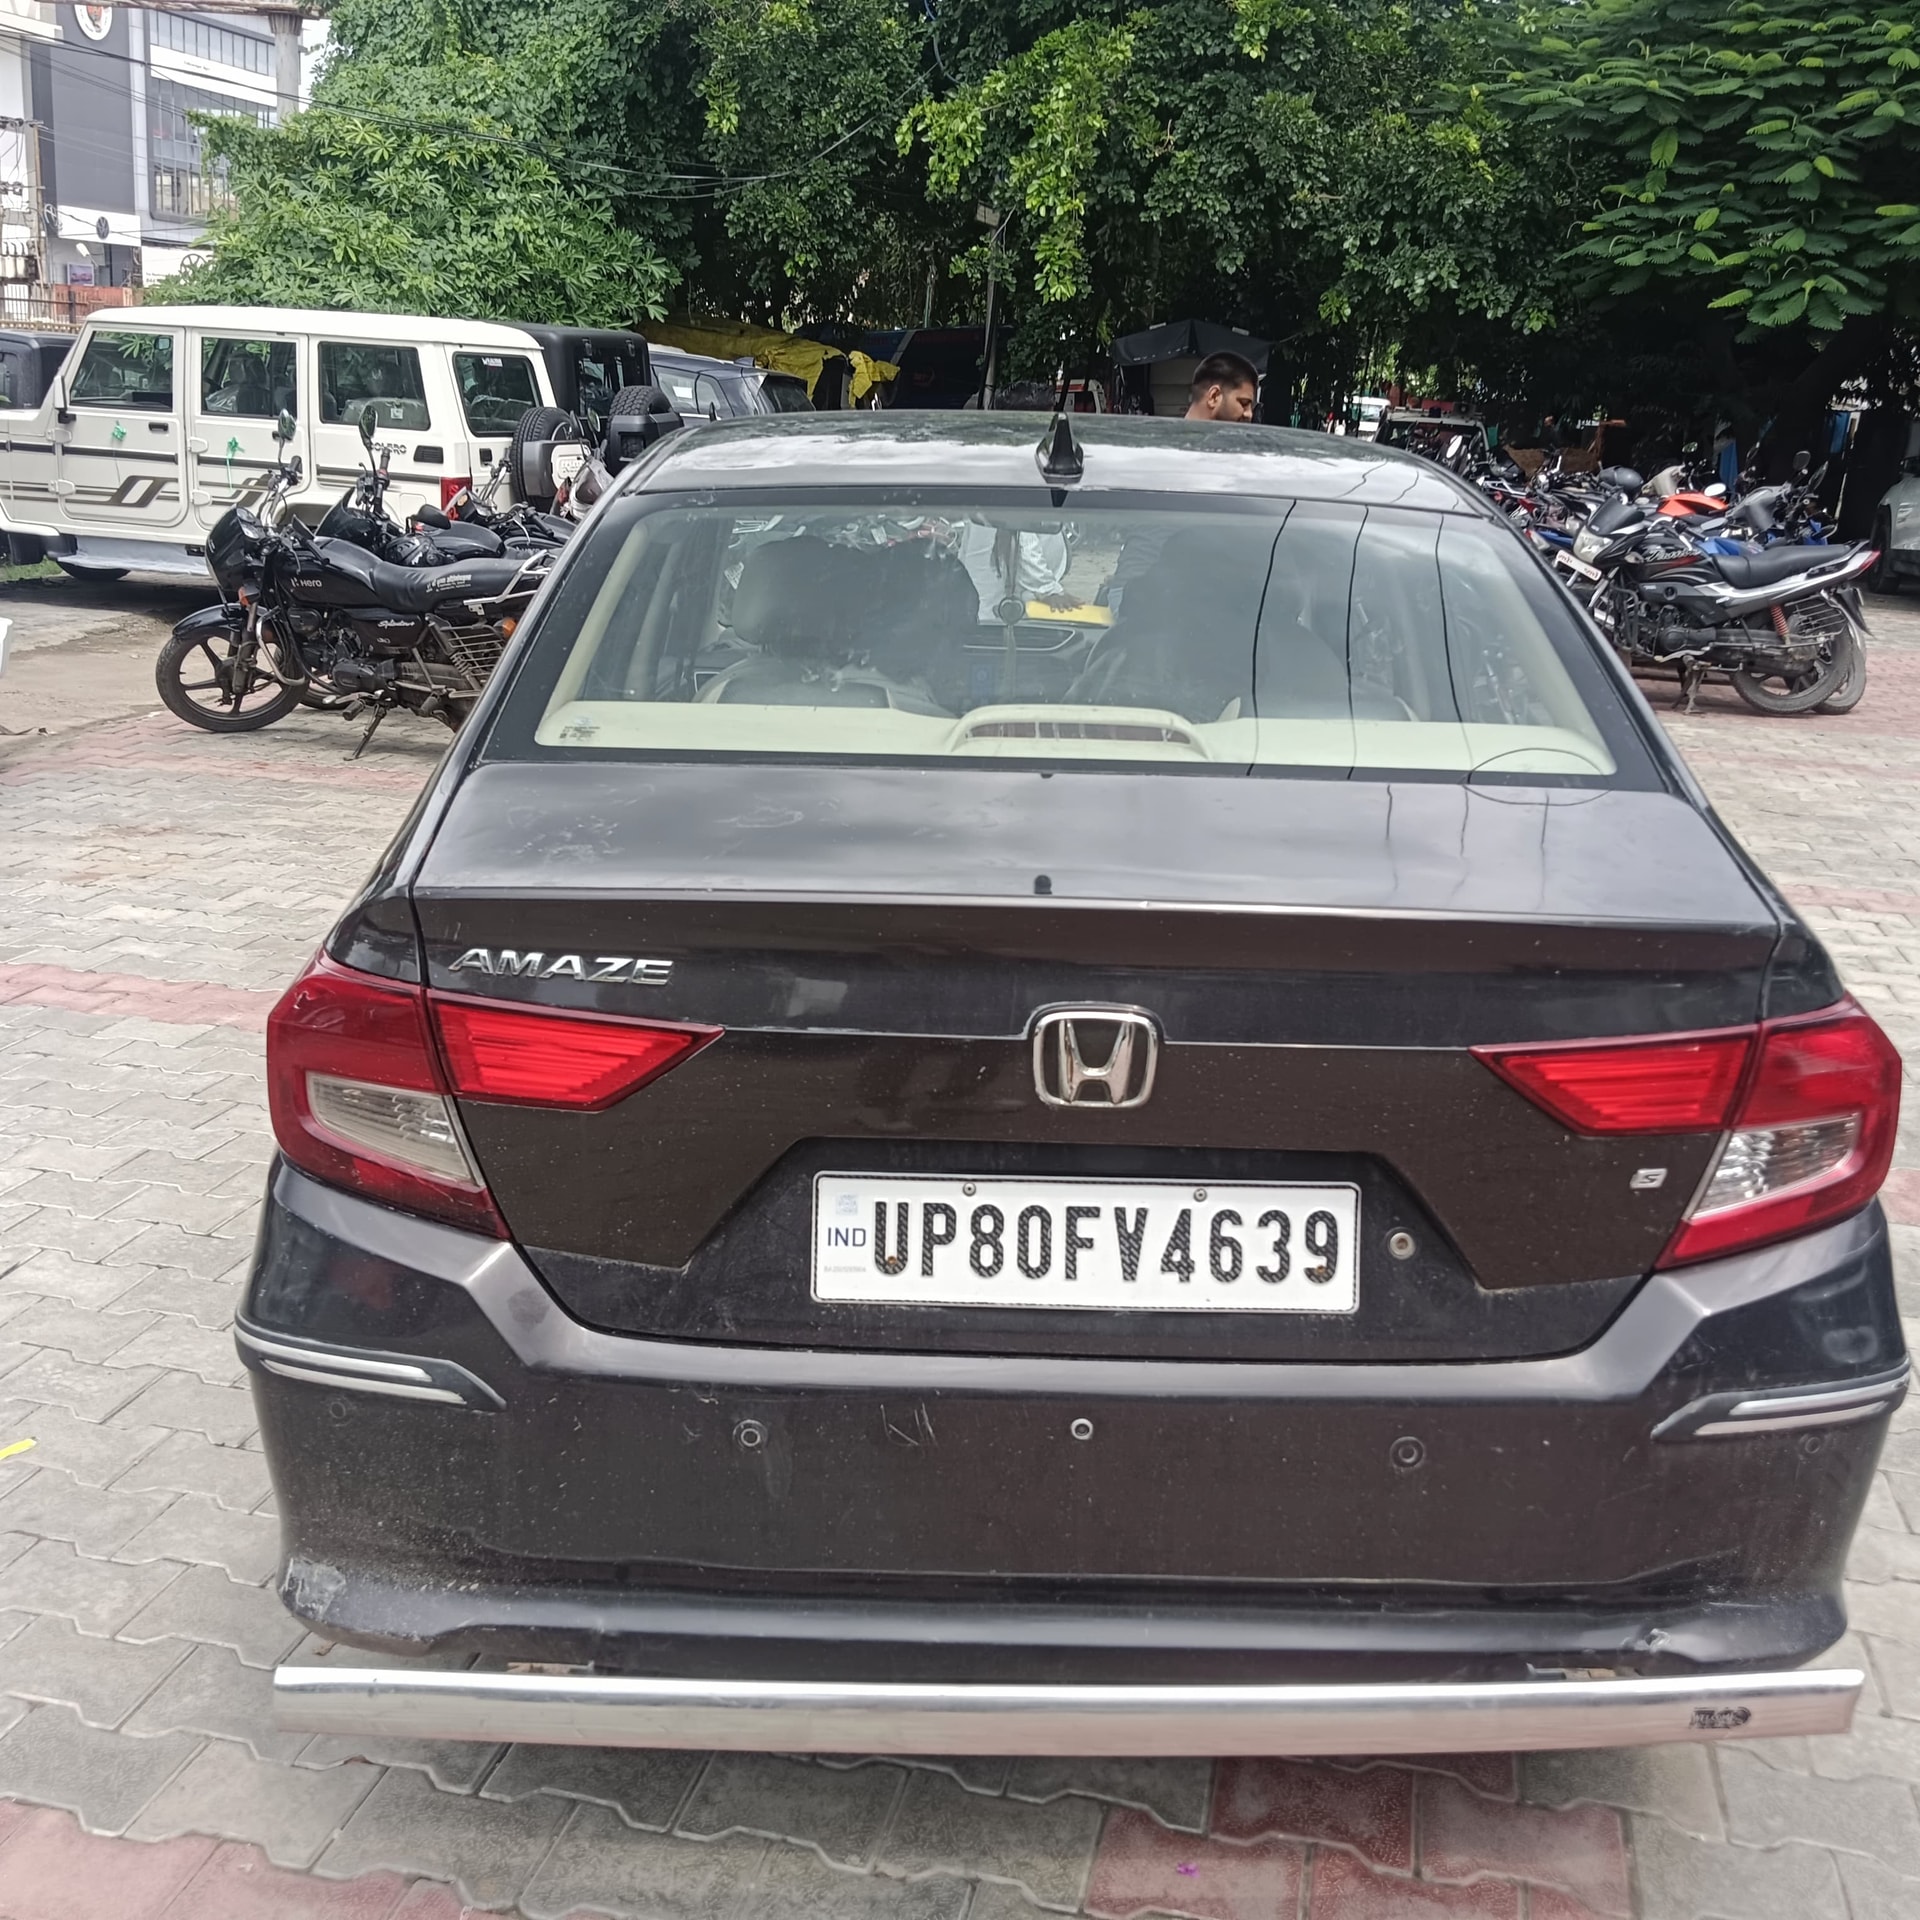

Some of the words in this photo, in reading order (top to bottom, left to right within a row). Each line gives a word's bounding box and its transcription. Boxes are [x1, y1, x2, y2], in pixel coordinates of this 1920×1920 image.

[448, 948, 674, 985] AMAZE
[828, 1227, 867, 1247] IND
[874, 1201, 1338, 1284] UP80FV4639
